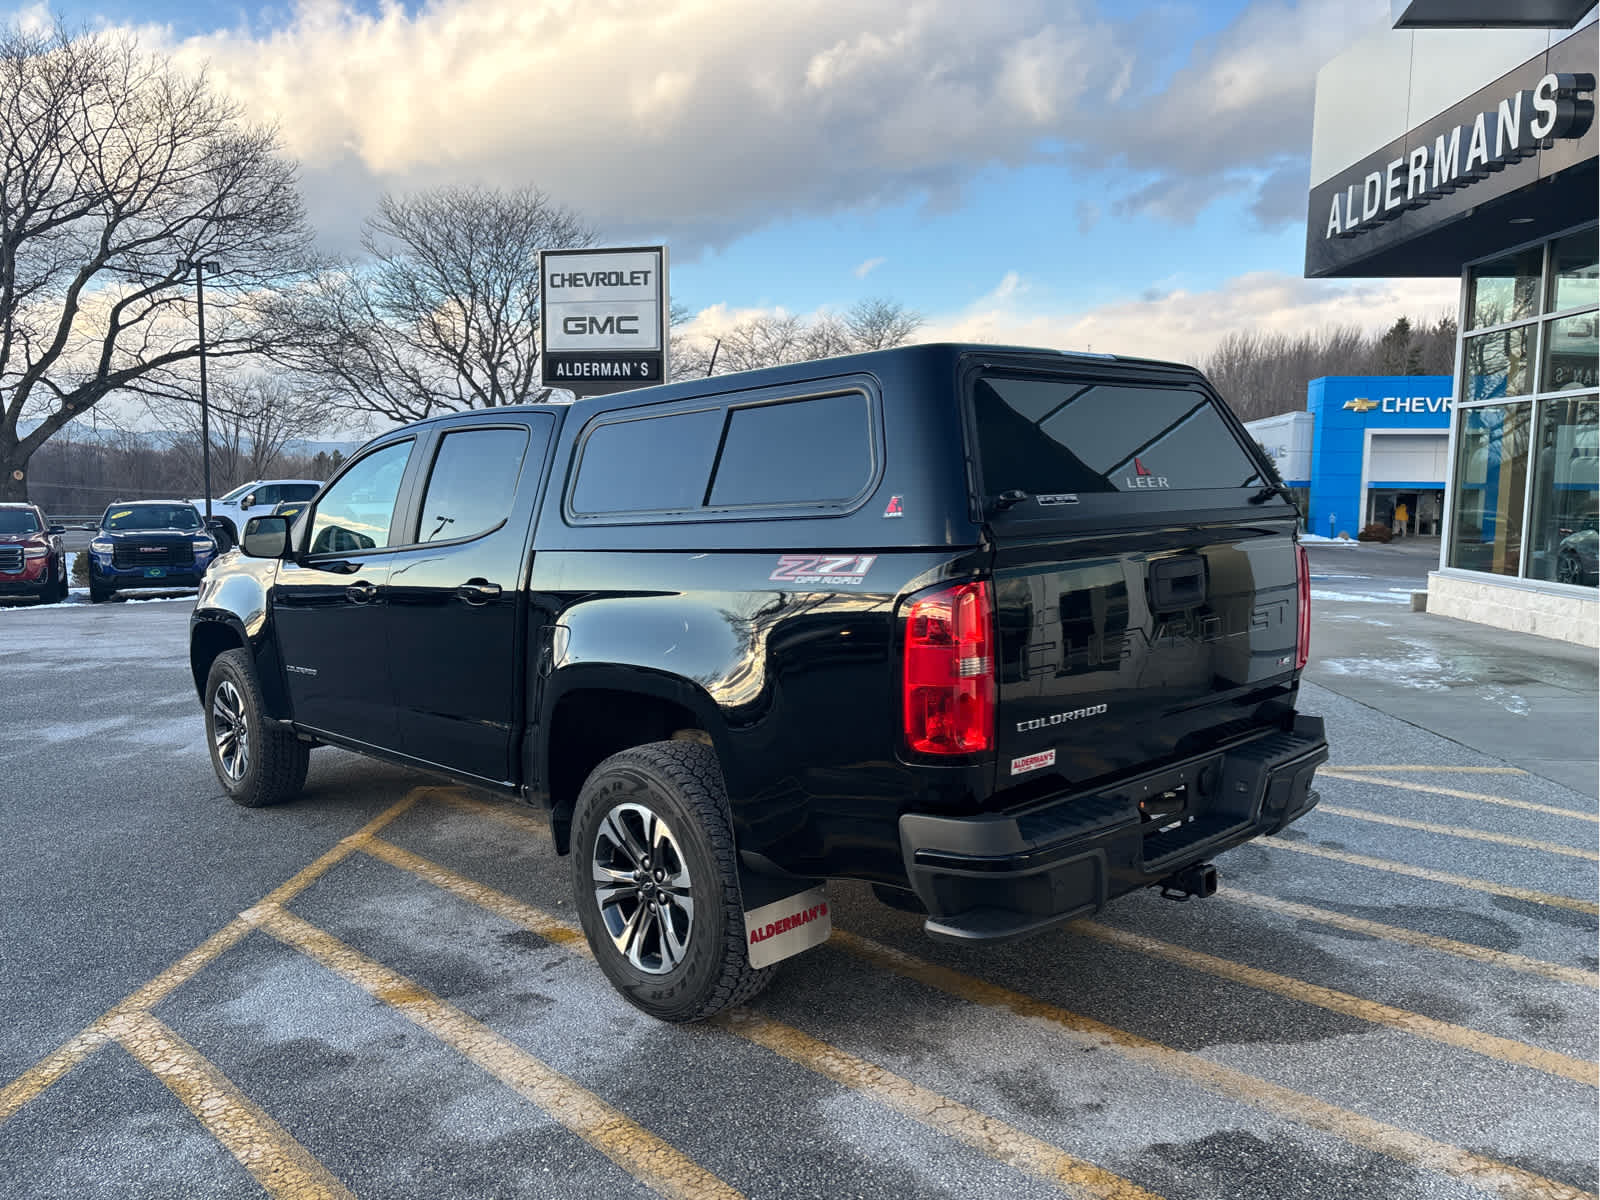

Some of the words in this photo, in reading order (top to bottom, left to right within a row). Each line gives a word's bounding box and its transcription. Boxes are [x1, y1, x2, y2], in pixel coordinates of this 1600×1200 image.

[550, 270, 652, 289] CHEVROLET
[563, 316, 639, 335] GMC
[556, 362, 649, 377] ALDERMAN'S
[1126, 476, 1170, 489] LEER
[794, 576, 821, 585] OFF
[821, 576, 864, 585] ROAD
[1016, 703, 1108, 732] COLORADO
[750, 902, 828, 945] ALDERMAN'S
